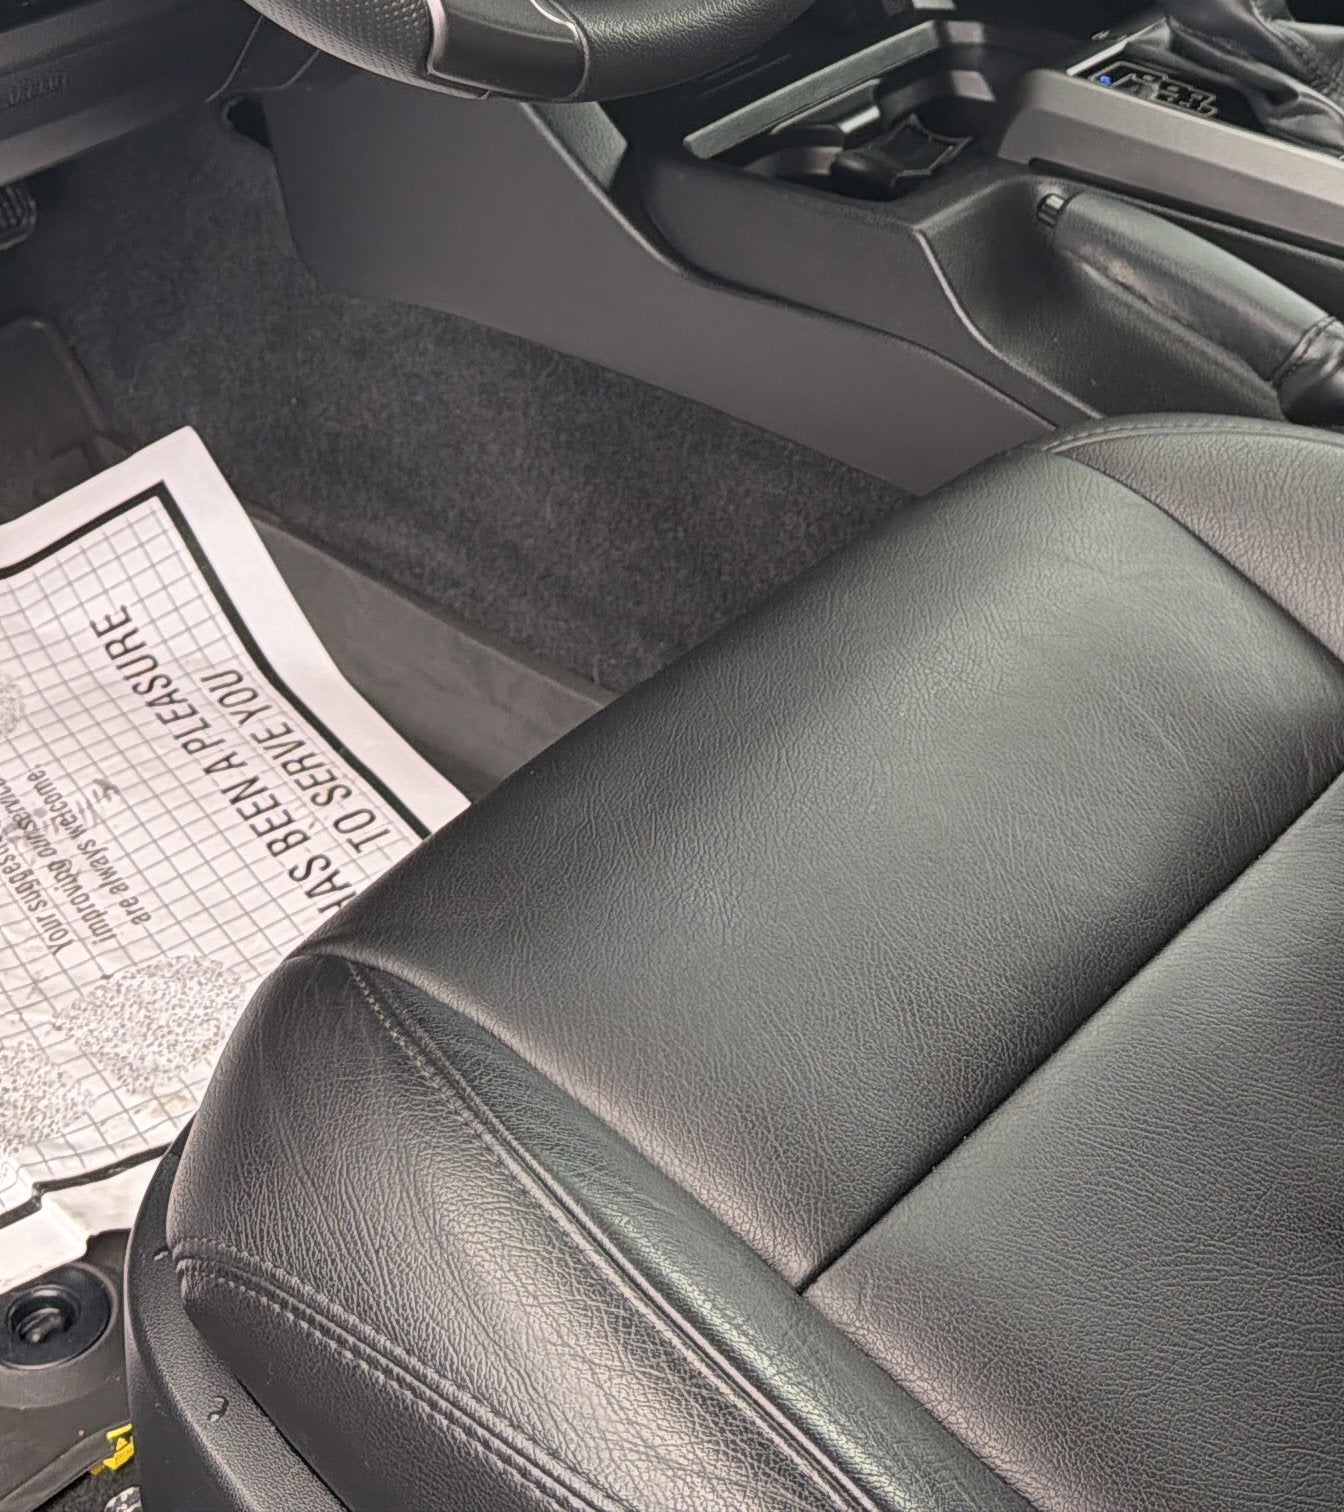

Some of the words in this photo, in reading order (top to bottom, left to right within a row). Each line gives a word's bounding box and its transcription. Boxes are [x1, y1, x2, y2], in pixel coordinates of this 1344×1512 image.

[90, 604, 226, 755] PLEASURE
[201, 669, 272, 725] YOU
[203, 750, 248, 775] A
[250, 727, 352, 806] SERVE
[221, 775, 311, 858] BEEN
[333, 808, 391, 854] TO
[77, 838, 131, 895] always
[47, 858, 117, 945] improving
[119, 895, 152, 925] are
[36, 913, 75, 956] Your
